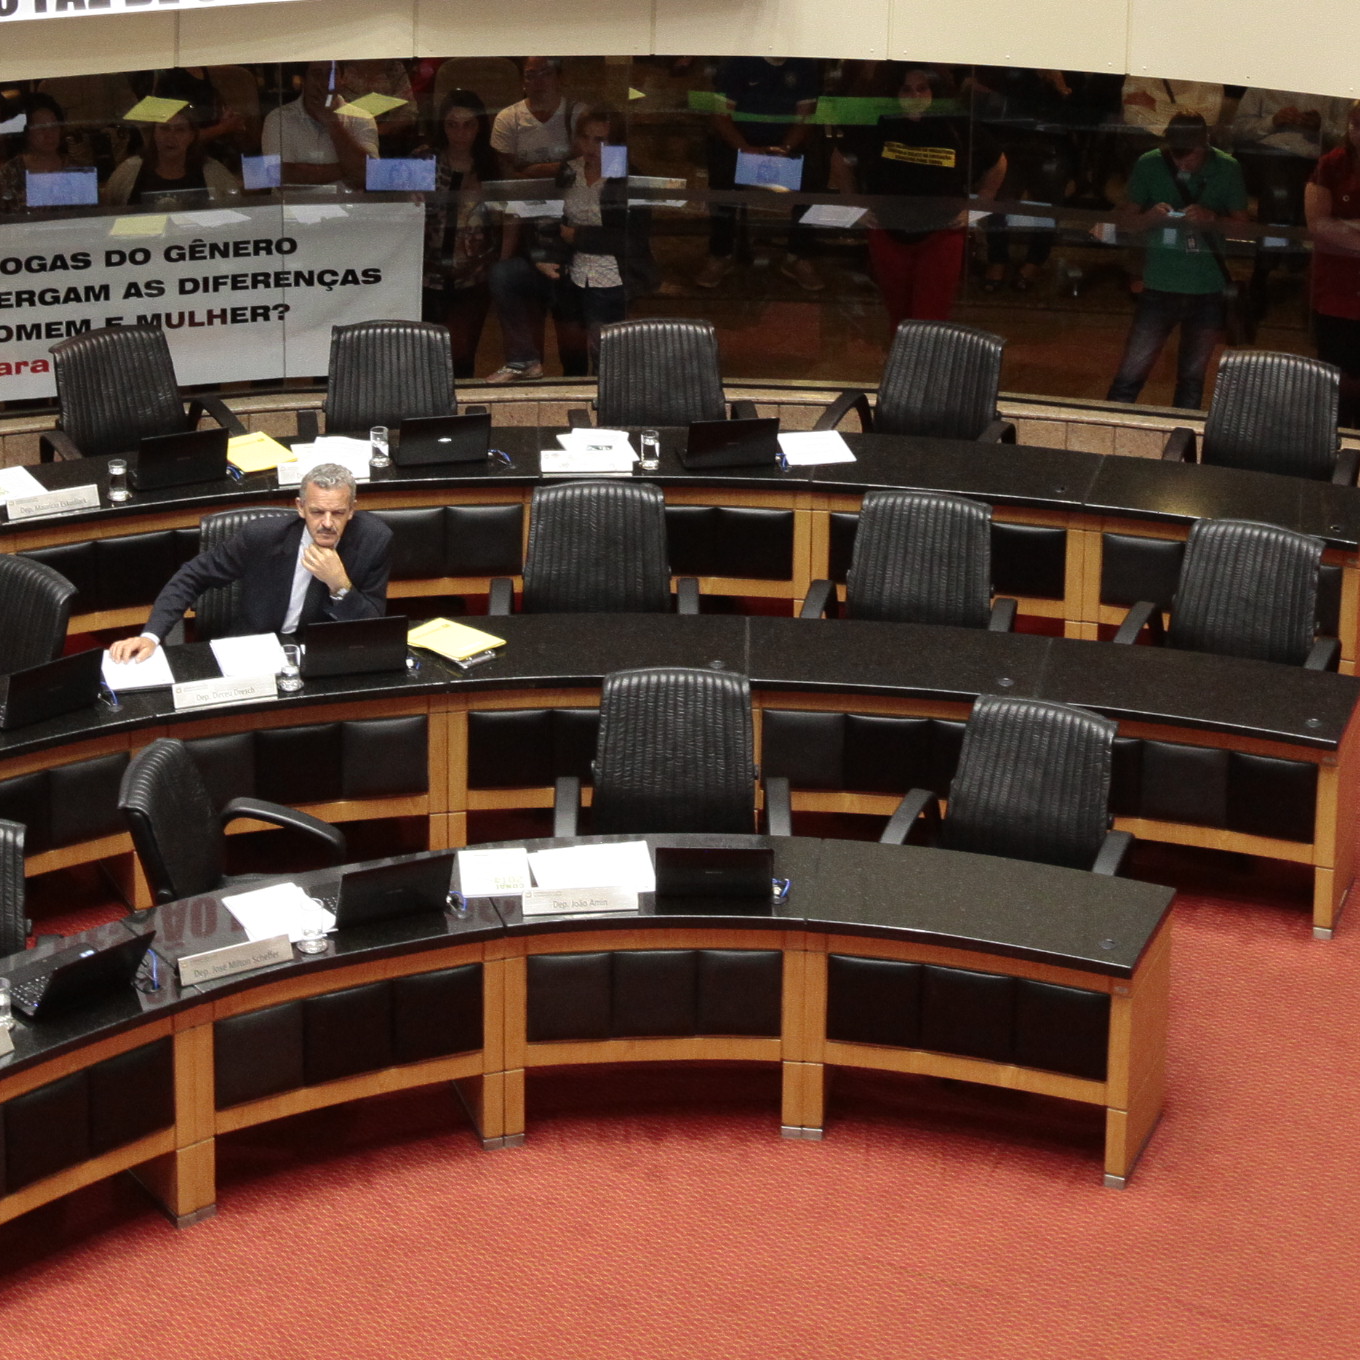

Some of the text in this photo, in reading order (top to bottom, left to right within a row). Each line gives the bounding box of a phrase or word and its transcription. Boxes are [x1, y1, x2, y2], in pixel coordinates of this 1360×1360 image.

[104, 247, 152, 270] DO
[170, 235, 298, 264] GÊNERO
[122, 277, 166, 300] AS
[184, 266, 383, 297] DIFERENÇAS
[135, 302, 292, 334] MULHER?
[553, 898, 608, 910] Dep. João Amin
[193, 969, 210, 978] Dep.
